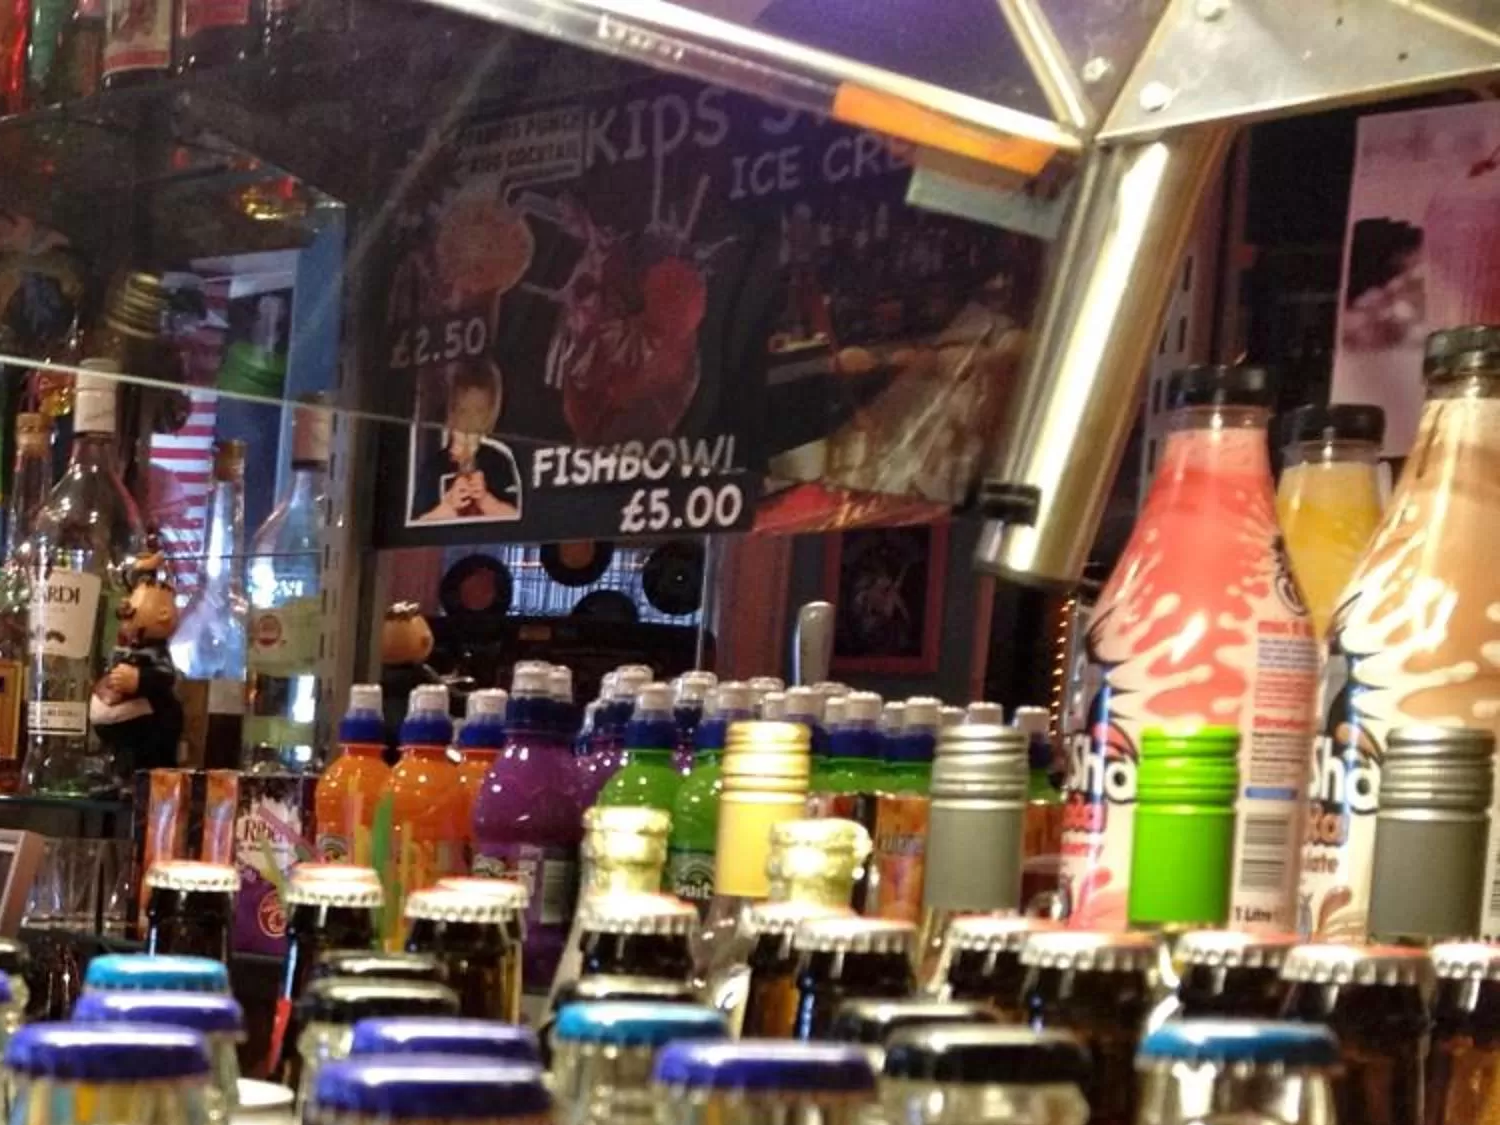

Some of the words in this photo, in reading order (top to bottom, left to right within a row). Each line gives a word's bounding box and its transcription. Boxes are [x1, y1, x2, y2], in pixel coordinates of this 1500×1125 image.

[728, 145, 803, 201] ICE
[389, 316, 488, 371] £2.50
[532, 434, 747, 489] FISHBOWL
[620, 484, 744, 534] £5.00
